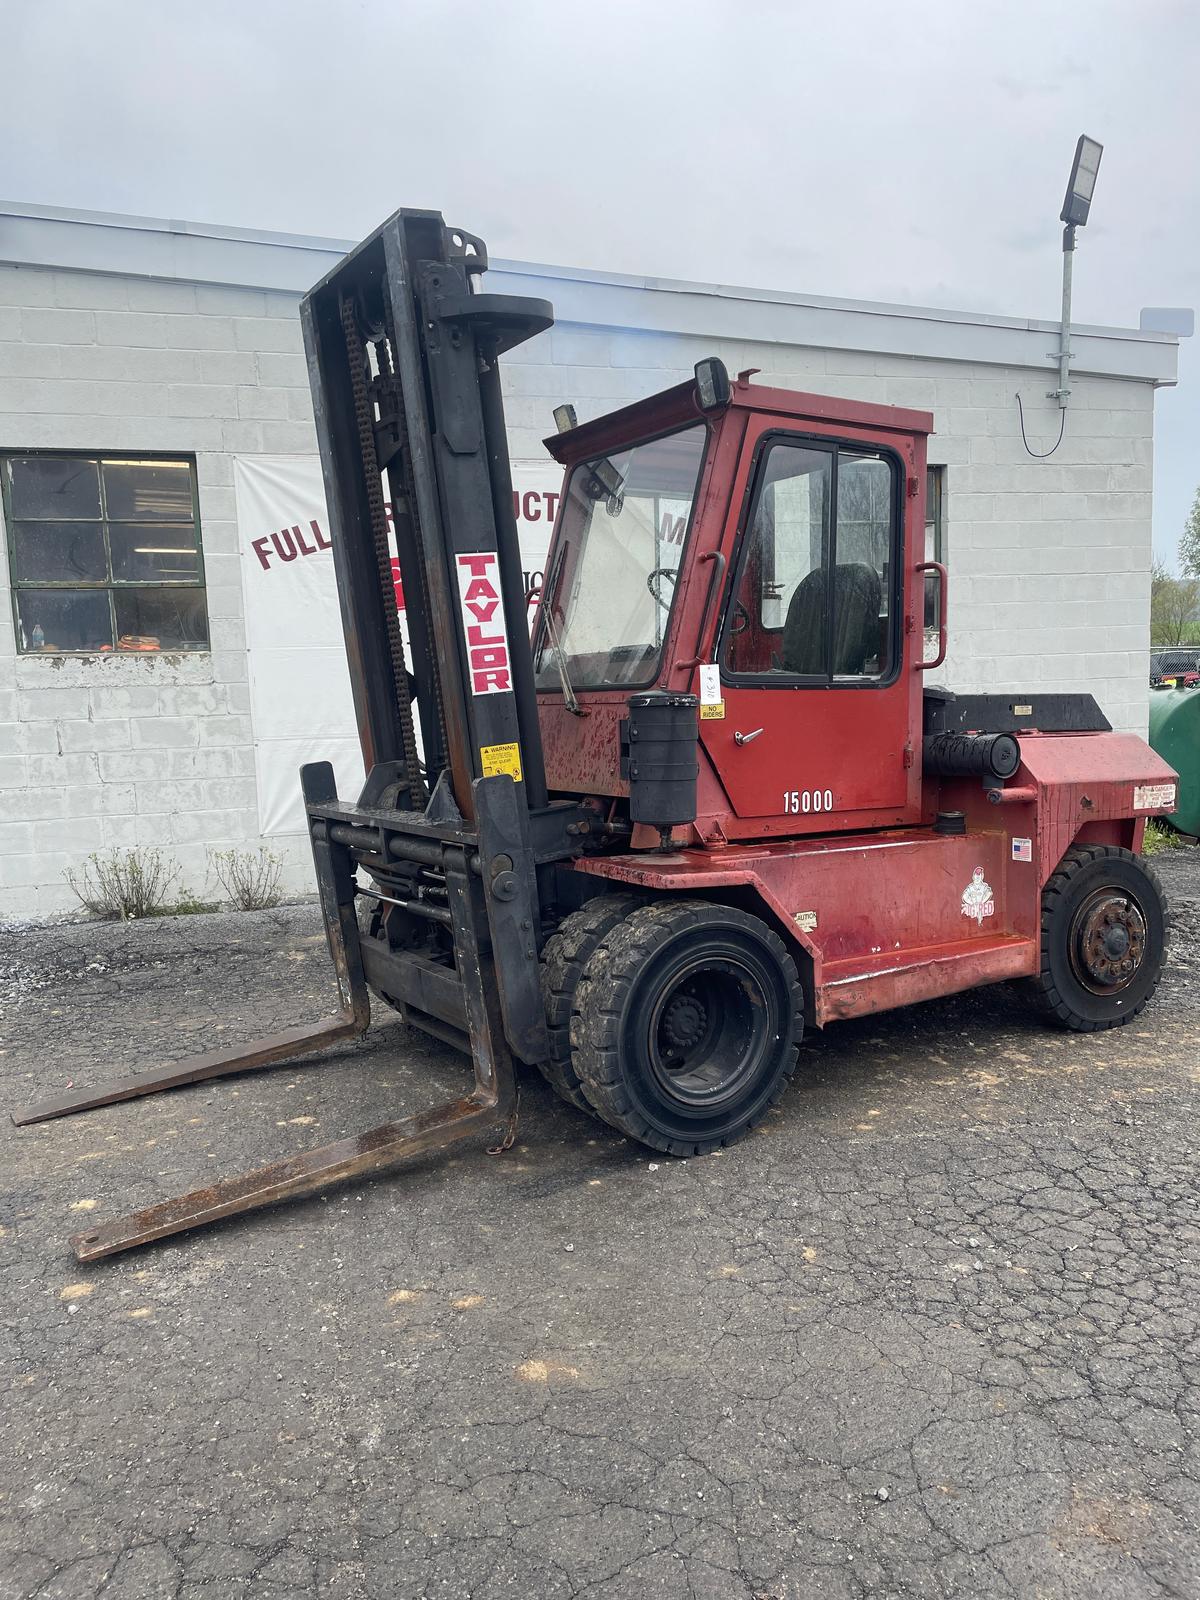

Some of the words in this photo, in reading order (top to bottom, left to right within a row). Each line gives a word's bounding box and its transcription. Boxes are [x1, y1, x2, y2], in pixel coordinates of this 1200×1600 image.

[251, 519, 333, 570] FULL
[458, 555, 511, 692] TAYLOR
[490, 745, 516, 753] WARNING
[783, 789, 833, 813] 15000
[978, 902, 993, 915] RED
